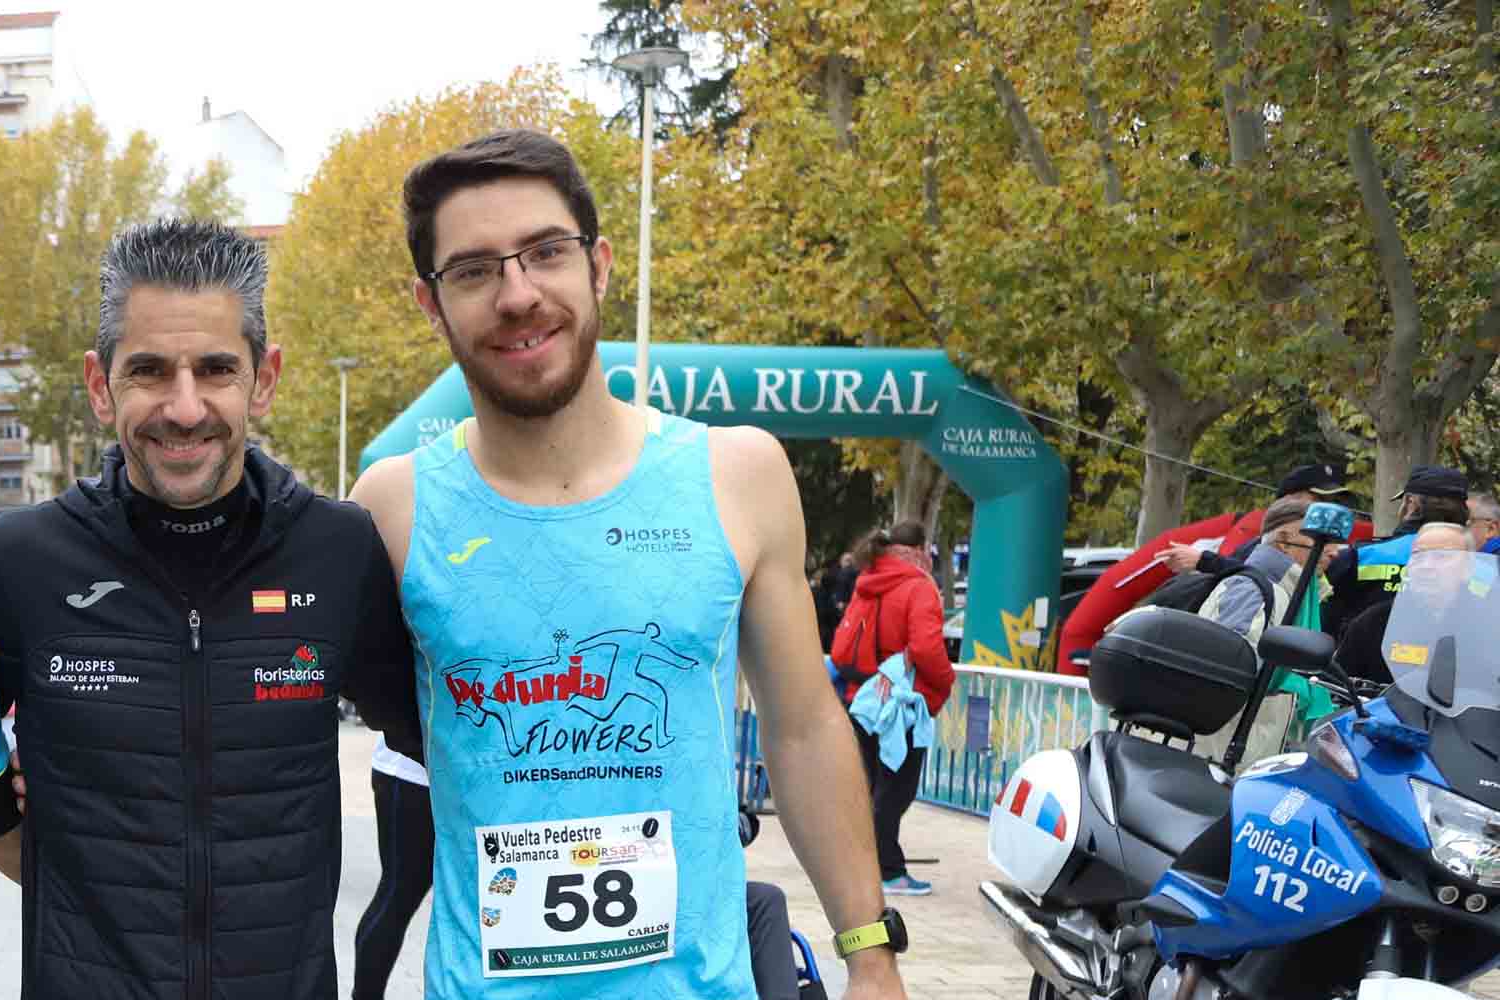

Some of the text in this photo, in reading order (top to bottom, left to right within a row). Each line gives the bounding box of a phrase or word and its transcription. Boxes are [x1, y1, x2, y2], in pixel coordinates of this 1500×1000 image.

[604, 365, 941, 416] CAJA RURAL
[943, 427, 1036, 445] CAJA RURAL
[960, 444, 1037, 458] SALAMANCA
[625, 528, 691, 541] HOSPES
[291, 592, 316, 607] R.P
[66, 660, 116, 672] HOSPES
[89, 675, 106, 683] SAN
[106, 675, 140, 684] ESTEBAN
[525, 720, 653, 754] FLOWERS
[503, 765, 663, 784] BIKERSandRUNNERS
[501, 829, 541, 848] Vuelta
[544, 825, 602, 845] Pedestre
[500, 849, 560, 864] Salamanca
[1236, 820, 1368, 895] Policía Local
[1254, 864, 1309, 913] 112
[544, 869, 638, 932] 58
[627, 923, 670, 937] CARLOS
[512, 940, 667, 967] CAJA RURAL DE SALAMANCA
